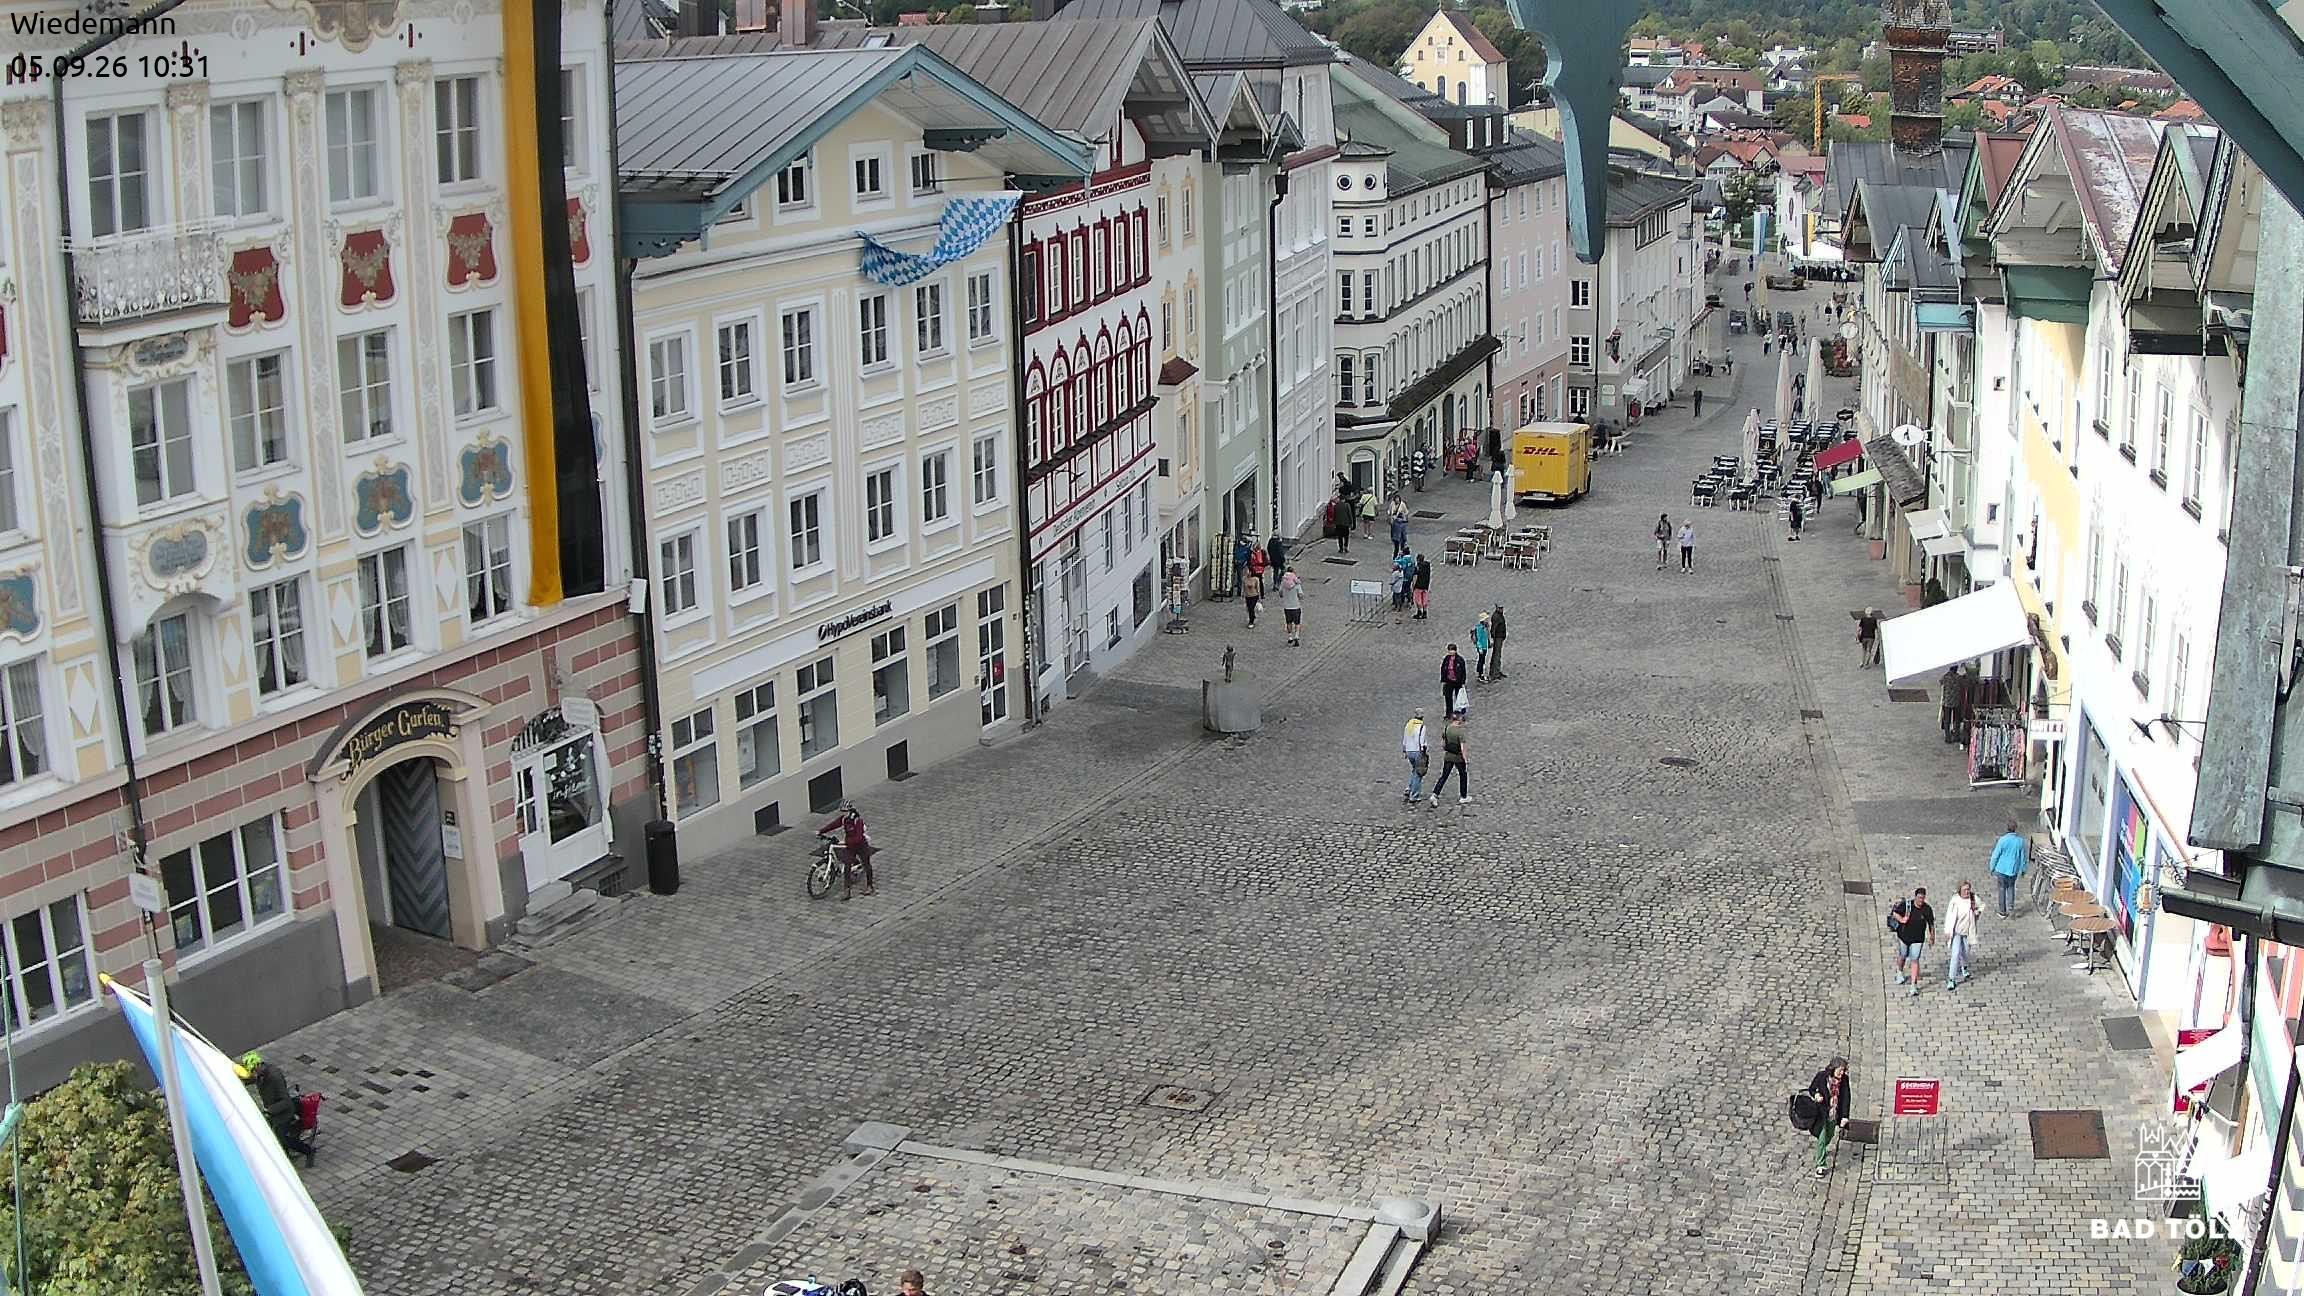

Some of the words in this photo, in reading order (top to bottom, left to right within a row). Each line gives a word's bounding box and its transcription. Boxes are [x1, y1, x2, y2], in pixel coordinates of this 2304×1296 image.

[1522, 446, 1560, 456] DHL
[827, 599, 893, 638] HypoVereinsbank
[349, 721, 396, 766] Bürger
